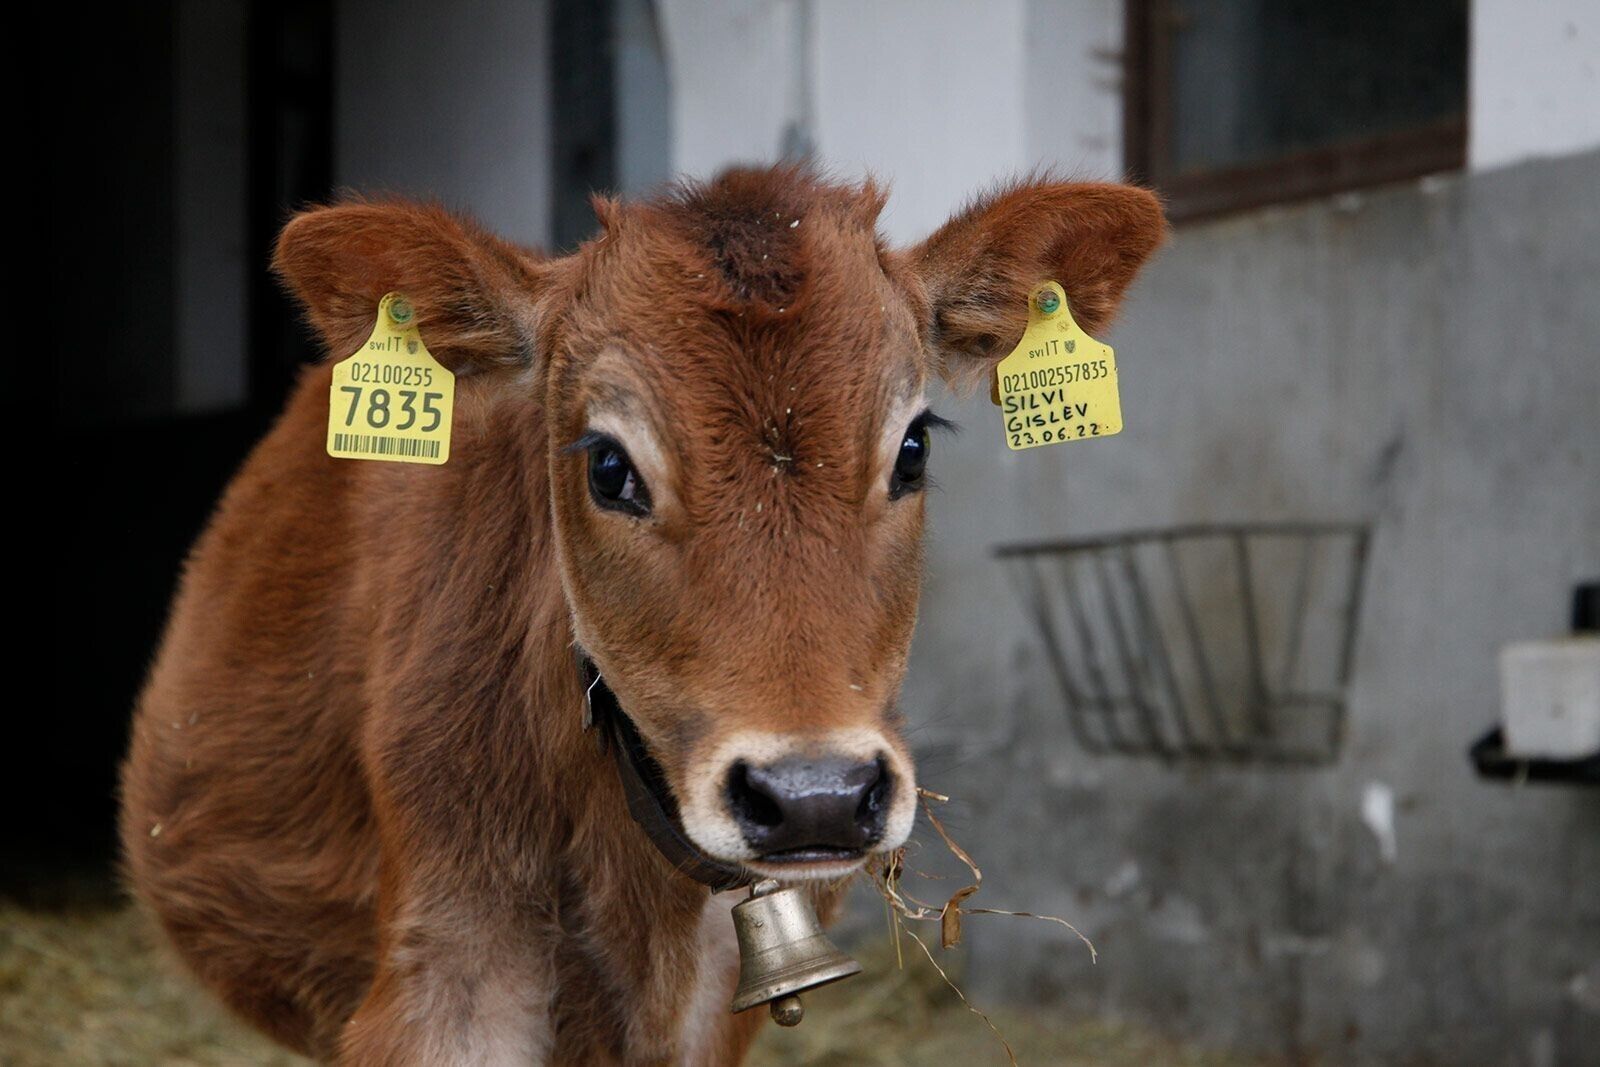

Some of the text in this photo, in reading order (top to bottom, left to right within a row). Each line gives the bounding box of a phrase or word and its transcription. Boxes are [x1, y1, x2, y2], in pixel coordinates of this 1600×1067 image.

[351, 362, 433, 387] 02100255
[1003, 360, 1108, 394] 021002557835
[340, 386, 443, 432] 7835
[1004, 389, 1064, 414] SILVI
[1007, 403, 1088, 433] GISLEV
